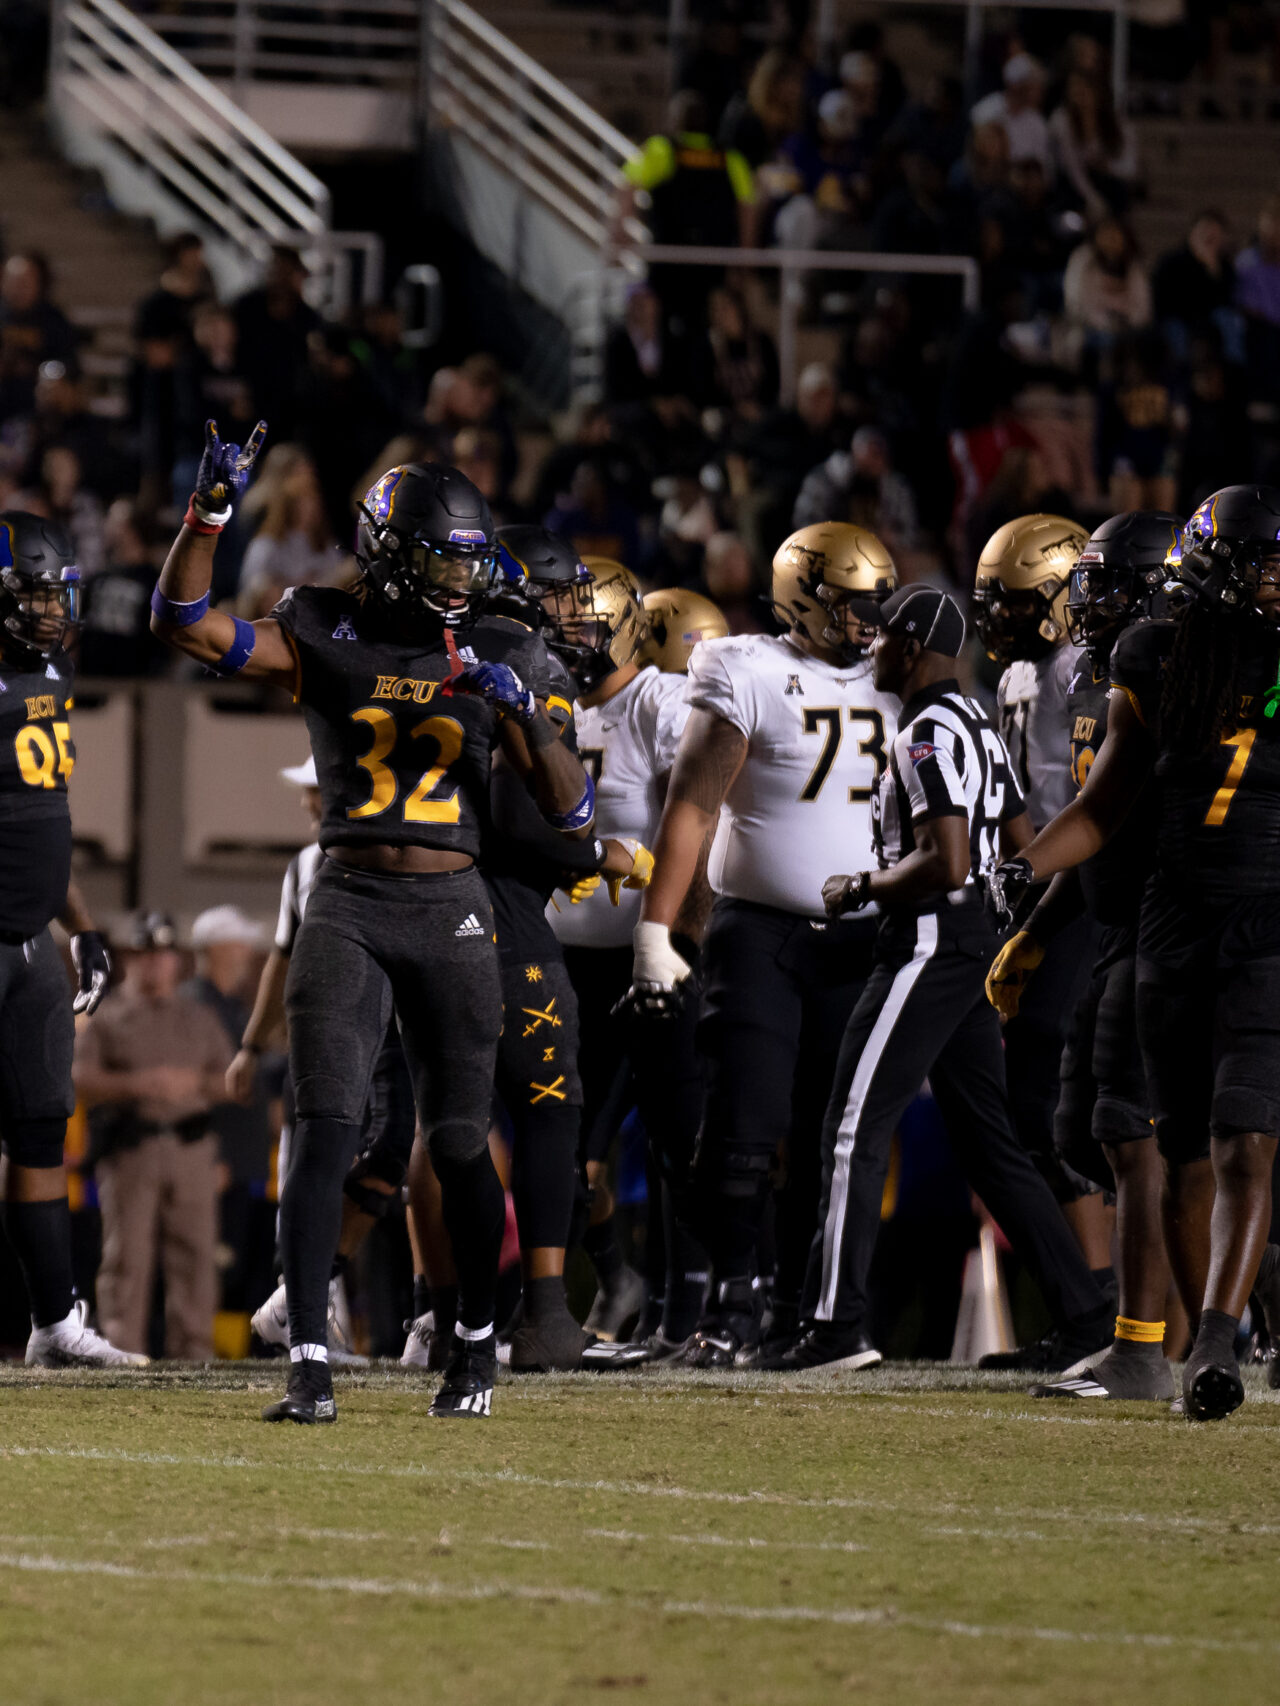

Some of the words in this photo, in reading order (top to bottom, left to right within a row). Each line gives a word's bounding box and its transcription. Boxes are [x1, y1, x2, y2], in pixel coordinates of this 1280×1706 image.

[370, 675, 441, 704] ECU
[24, 695, 56, 720] ECU
[345, 705, 465, 825] 32
[797, 705, 889, 804] 73
[455, 927, 485, 937] adidas
